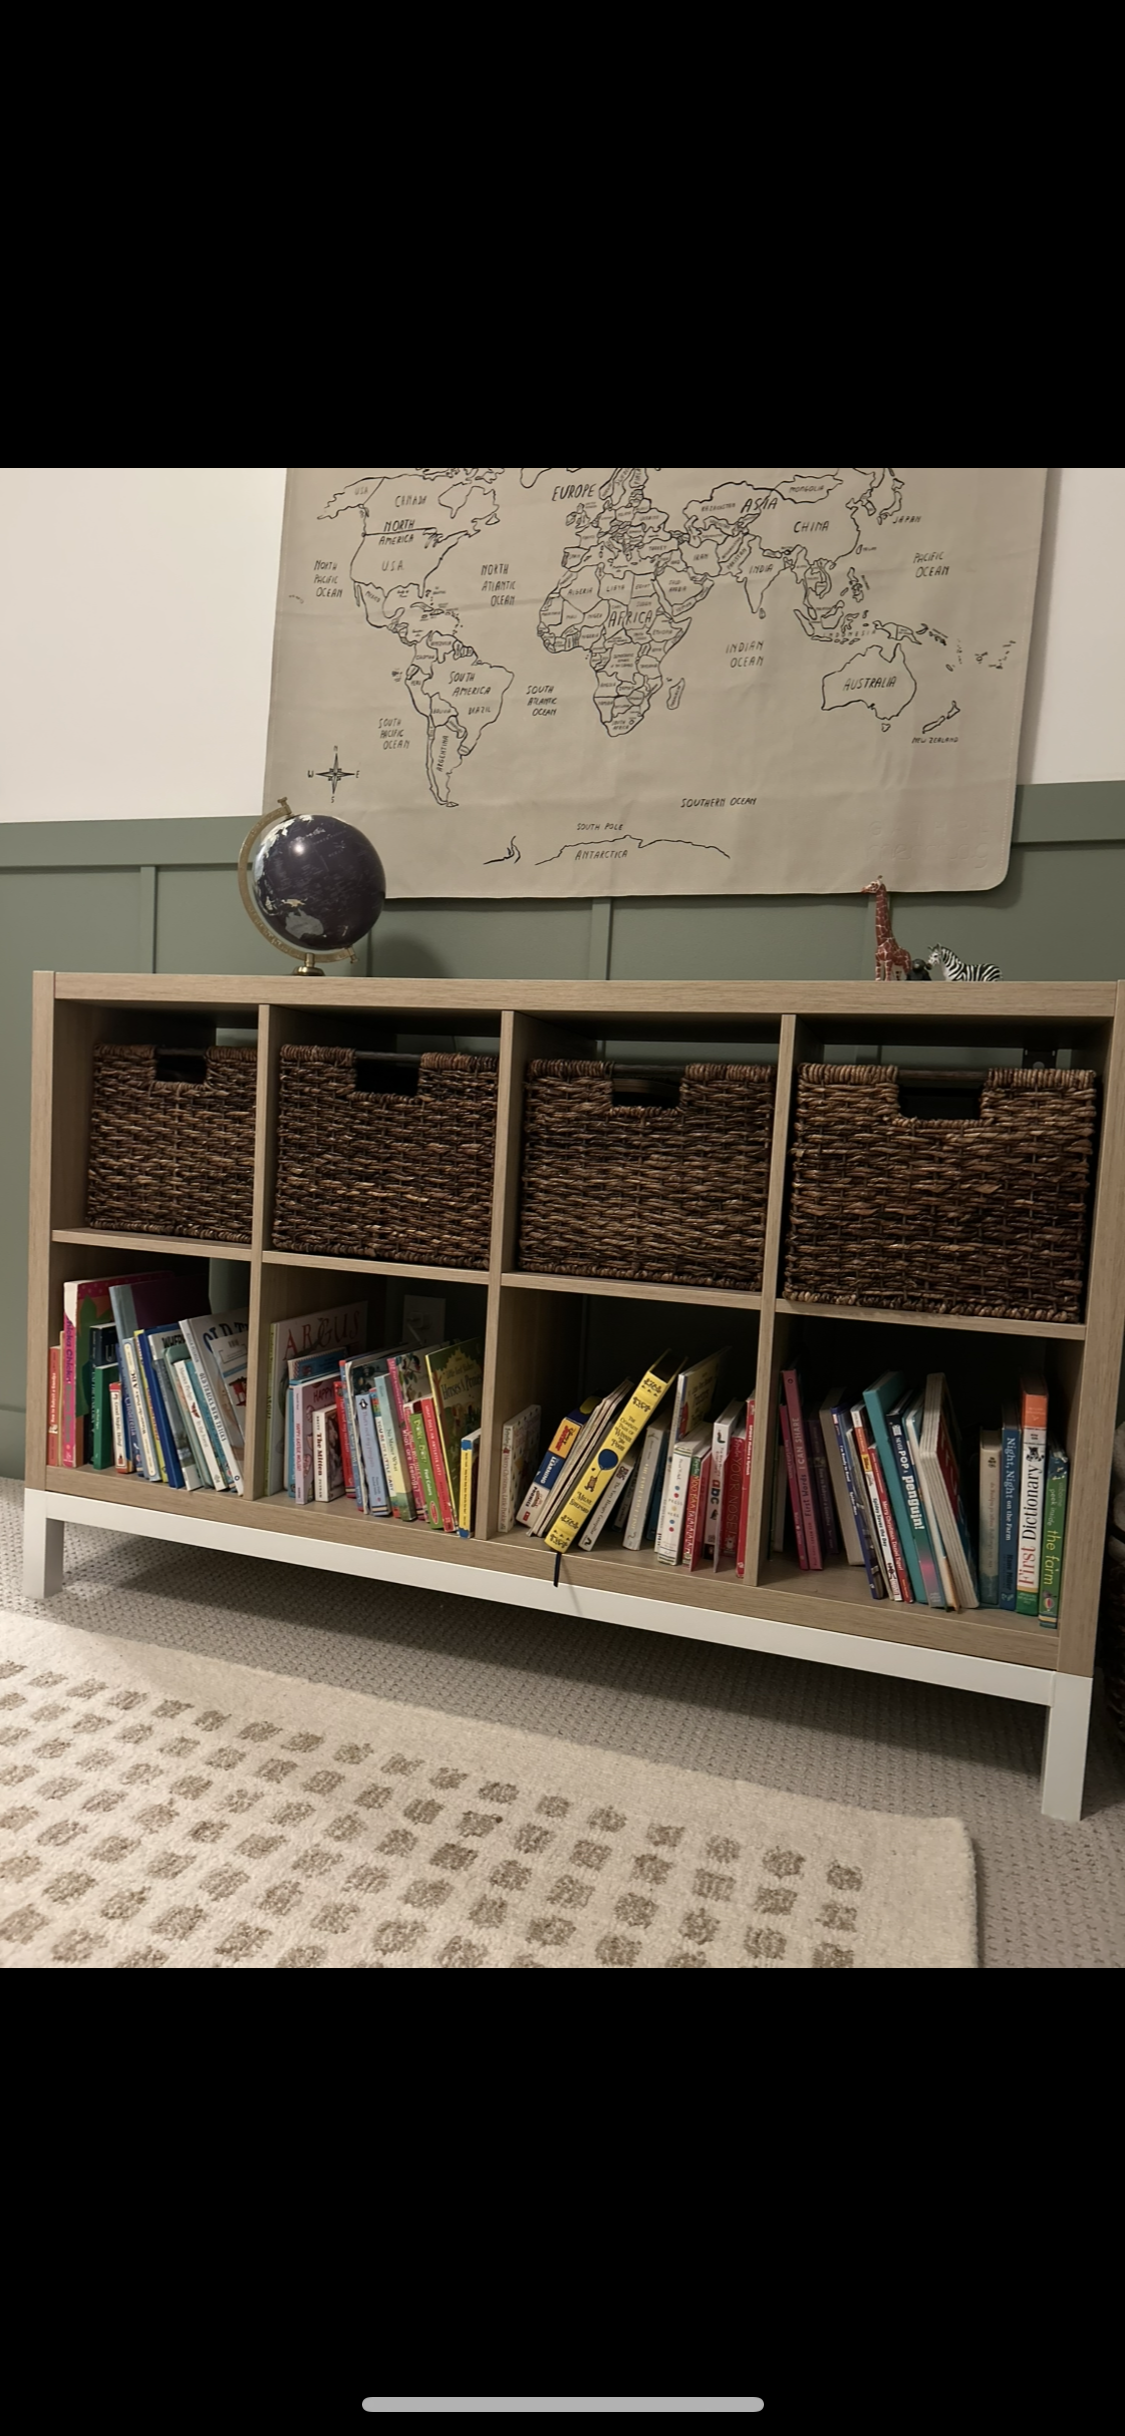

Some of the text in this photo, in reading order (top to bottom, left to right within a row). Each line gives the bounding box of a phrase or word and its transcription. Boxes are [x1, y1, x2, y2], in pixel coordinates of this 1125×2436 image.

[552, 483, 597, 502] EUROPE
[789, 485, 825, 493] MONGOLIA
[395, 495, 427, 508] CANADA
[740, 497, 778, 514] ASIA
[384, 519, 415, 532] NORTH
[892, 515, 922, 524] JAPAN
[793, 520, 830, 533] CHINA
[378, 534, 414, 546] AMERICA
[693, 553, 708, 561] IRAN
[912, 551, 945, 564] PACIFIC
[313, 560, 338, 571] NORTH
[480, 563, 510, 576] NORTH
[748, 563, 774, 574] INDIA
[915, 566, 950, 578] OCEAN
[313, 574, 338, 584] PACIFIC
[316, 586, 342, 598] OCEAN
[481, 580, 516, 592] ATLANTIC
[567, 588, 593, 596] ALGERIA
[606, 584, 625, 592] LIBYA
[490, 594, 516, 607] OCEAN
[608, 610, 652, 628] AFRICA
[725, 641, 764, 654] INDIAN
[730, 656, 764, 668] OCEAN
[448, 671, 476, 685] SOUTH
[842, 676, 897, 692] AUSTRALIA
[452, 686, 492, 697] AMERICA
[526, 685, 554, 695] SOUTH
[527, 697, 558, 706] ATLANTIC
[468, 706, 491, 716] BRAZIL
[532, 708, 557, 717] OCEAN
[378, 718, 402, 729] SOUTH
[380, 729, 404, 739] PACIFIC
[929, 736, 958, 744] ZEALAND
[382, 740, 410, 750] OCEAN
[436, 735, 450, 772] ARGENTINA
[307, 770, 314, 778] W
[355, 770, 360, 778] E
[330, 796, 335, 804] S
[680, 797, 758, 808] SOUTHERN OCEAN
[576, 822, 624, 831] SOUTH POLE
[574, 850, 628, 861] ANTARCTICA
[285, 1311, 360, 1360] ARGUS
[790, 1416, 800, 1443] SHARE
[401, 1428, 410, 1445] What
[894, 1436, 904, 1450] NEVER
[405, 1448, 413, 1461] are
[794, 1445, 803, 1465] CAN
[897, 1449, 910, 1470] POP
[1004, 1437, 1016, 1469] Night,
[539, 1455, 557, 1485] LEARNING
[408, 1463, 419, 1493] feelings?
[1003, 1470, 1015, 1499] Night
[612, 1481, 620, 1490] The
[710, 1479, 721, 1504] abc
[798, 1473, 808, 1497] Words
[524, 1485, 537, 1507] PHONICS
[606, 1488, 615, 1499] Very
[725, 1457, 742, 1534] YOUR NOSE!
[598, 1498, 610, 1514] Hungry
[802, 1499, 811, 1516] First
[871, 1496, 881, 1514] Spidey
[900, 1474, 926, 1532] penguin!
[1005, 1500, 1011, 1510] on
[1020, 1464, 1041, 1540] Dictionary
[1046, 1488, 1057, 1526] peek inside
[875, 1514, 884, 1528] Saves
[879, 1528, 887, 1537] the
[880, 1500, 905, 1572] Merry Christmas, Daniel Tiger!
[881, 1537, 889, 1548] Day
[1042, 1529, 1061, 1586] the farm
[1017, 1545, 1035, 1585] First
[1004, 1554, 1013, 1590] Kane Miller
